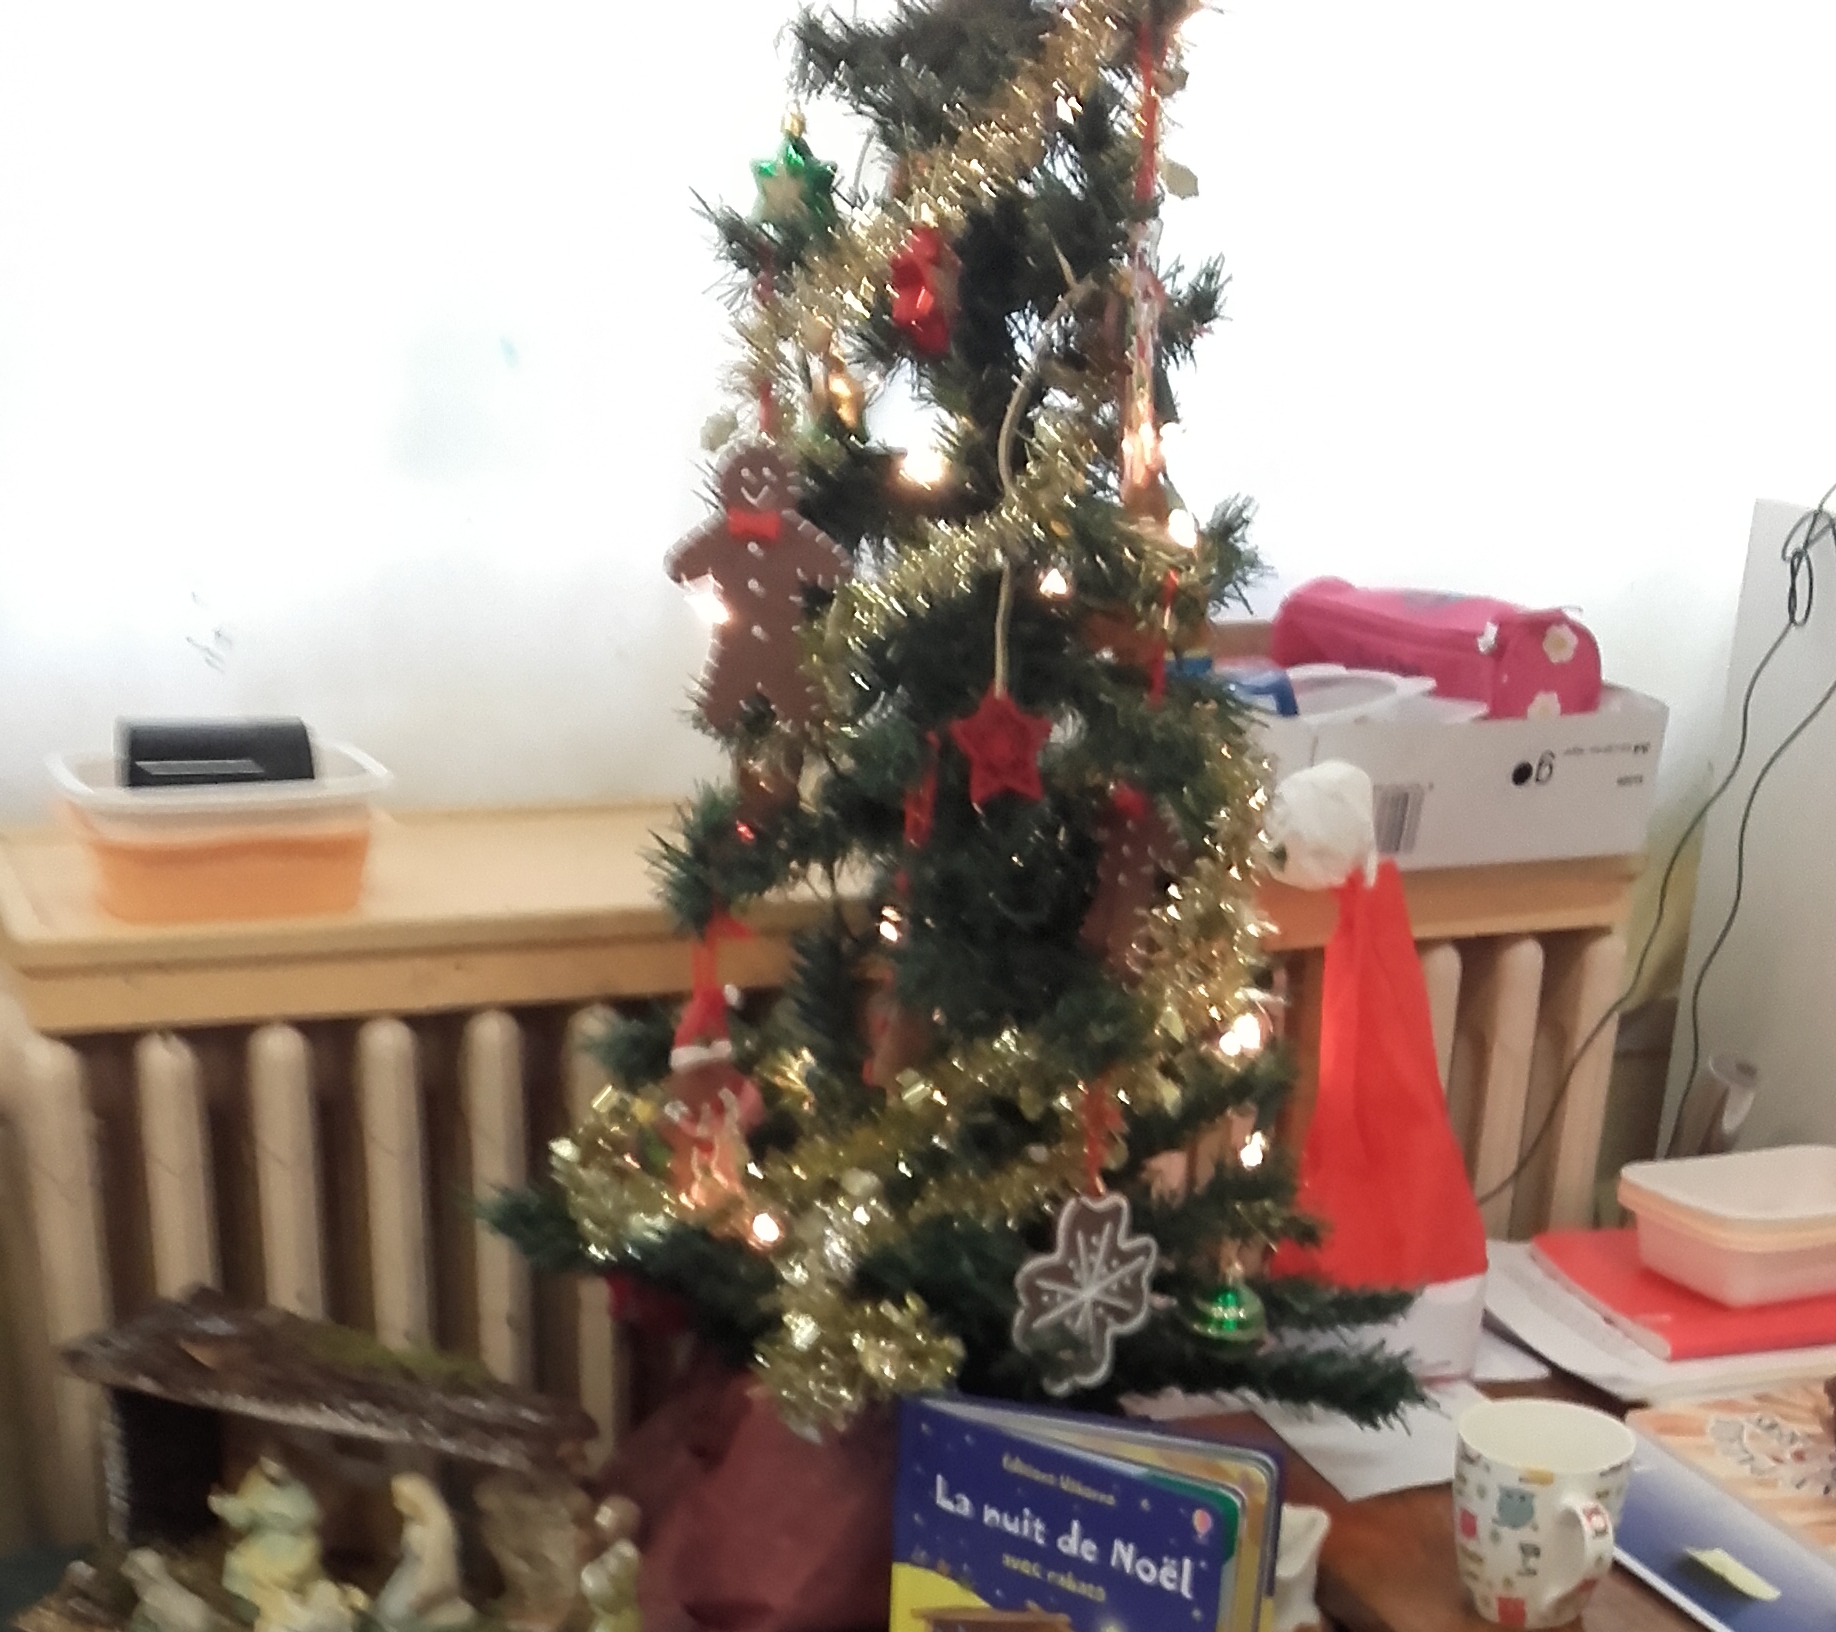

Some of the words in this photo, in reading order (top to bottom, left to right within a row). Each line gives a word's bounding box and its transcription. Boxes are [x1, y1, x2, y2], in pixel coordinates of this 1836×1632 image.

[935, 1473, 972, 1517] La
[982, 1504, 1046, 1545] nuit
[1056, 1519, 1098, 1563] de
[1110, 1537, 1193, 1600] Noël
